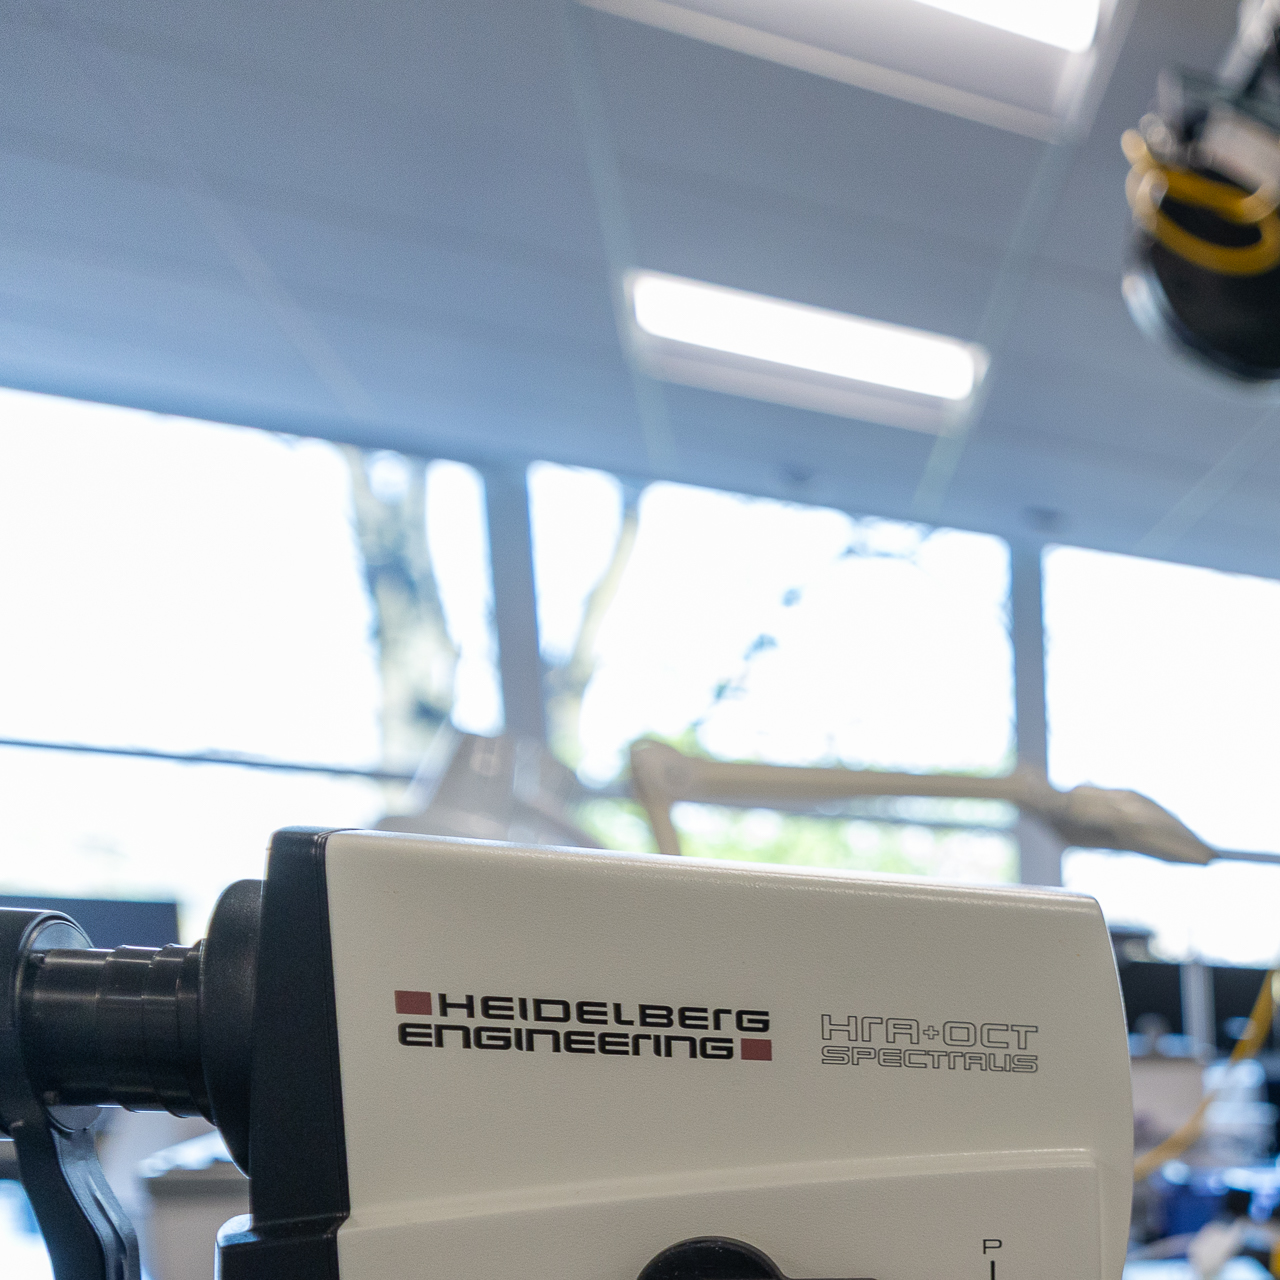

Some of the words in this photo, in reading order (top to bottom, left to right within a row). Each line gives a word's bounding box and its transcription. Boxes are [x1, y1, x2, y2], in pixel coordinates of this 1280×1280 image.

[438, 993, 770, 1034] HEIDELBERG
[397, 1022, 734, 1061] ENGINEERING
[821, 1044, 1039, 1074] SPECTRALIS
[982, 1238, 1003, 1256] P
